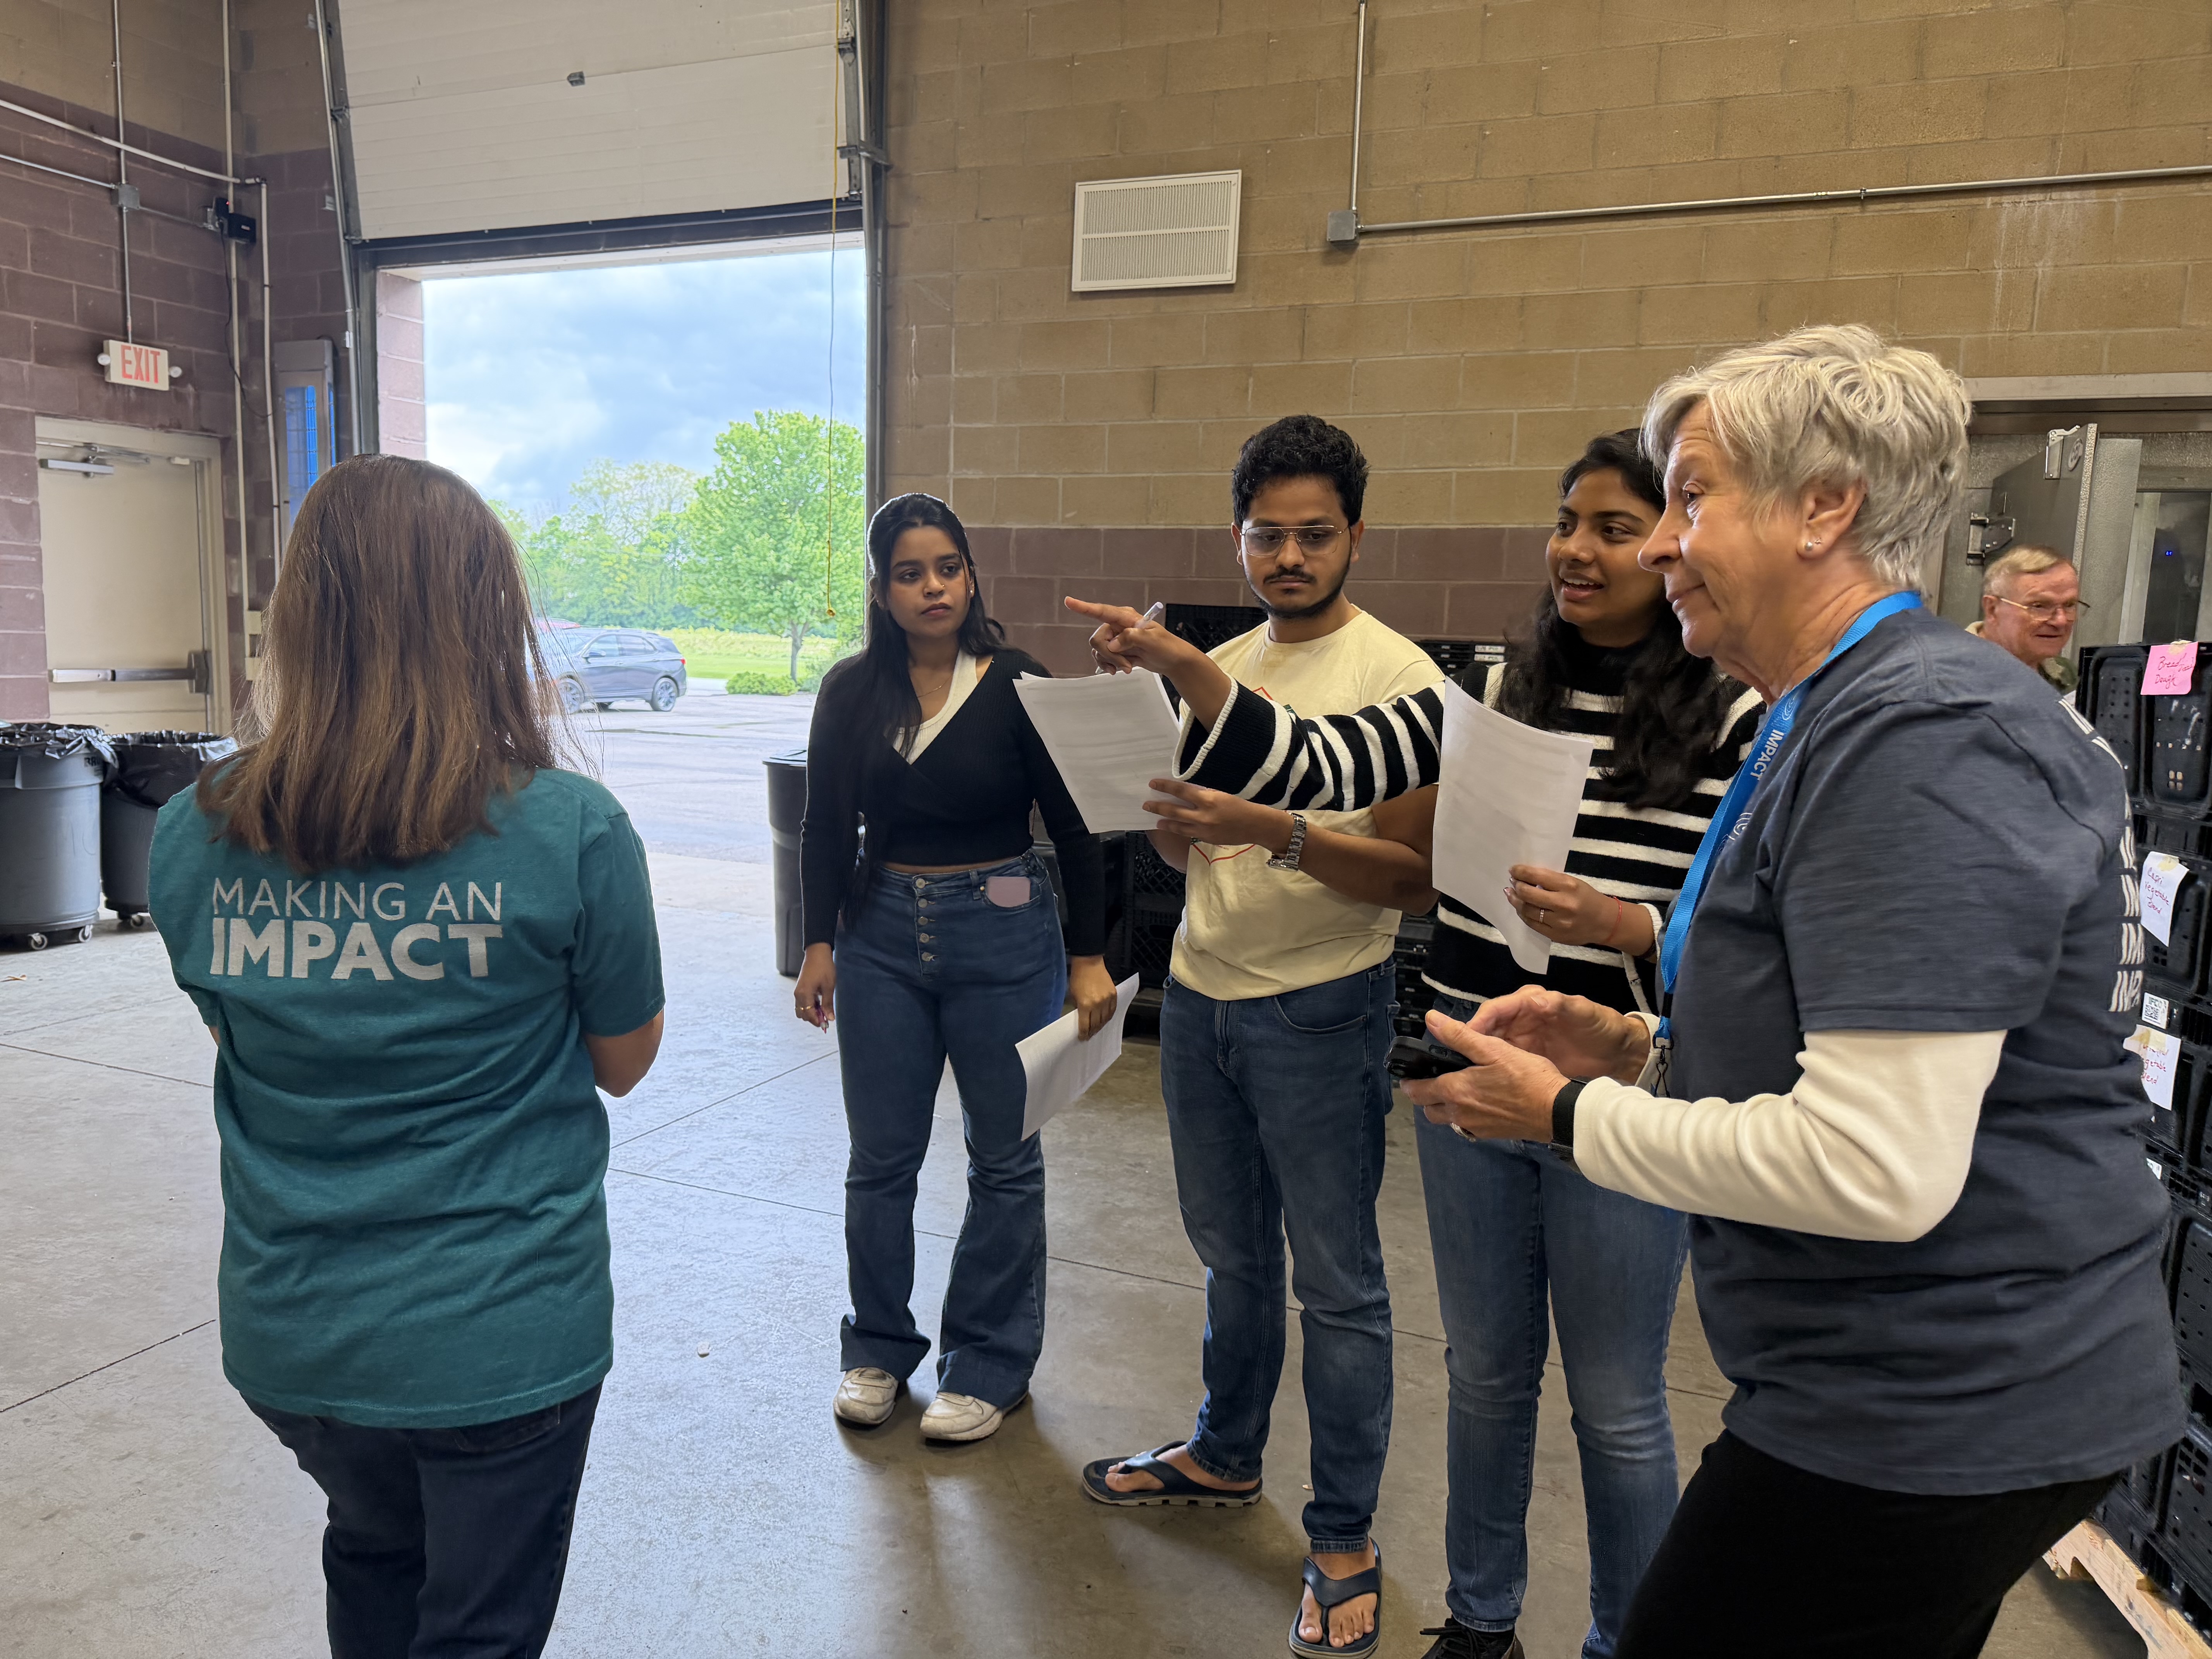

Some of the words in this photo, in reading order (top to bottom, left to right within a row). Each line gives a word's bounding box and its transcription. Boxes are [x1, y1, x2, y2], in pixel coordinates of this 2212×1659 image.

[121, 344, 160, 384] EXIT
[1750, 729, 1785, 781] IMPACT
[213, 878, 406, 921] MAKING
[425, 882, 502, 921] AN
[210, 917, 503, 981] IMPACT
[2142, 1072, 2159, 1085] lend
